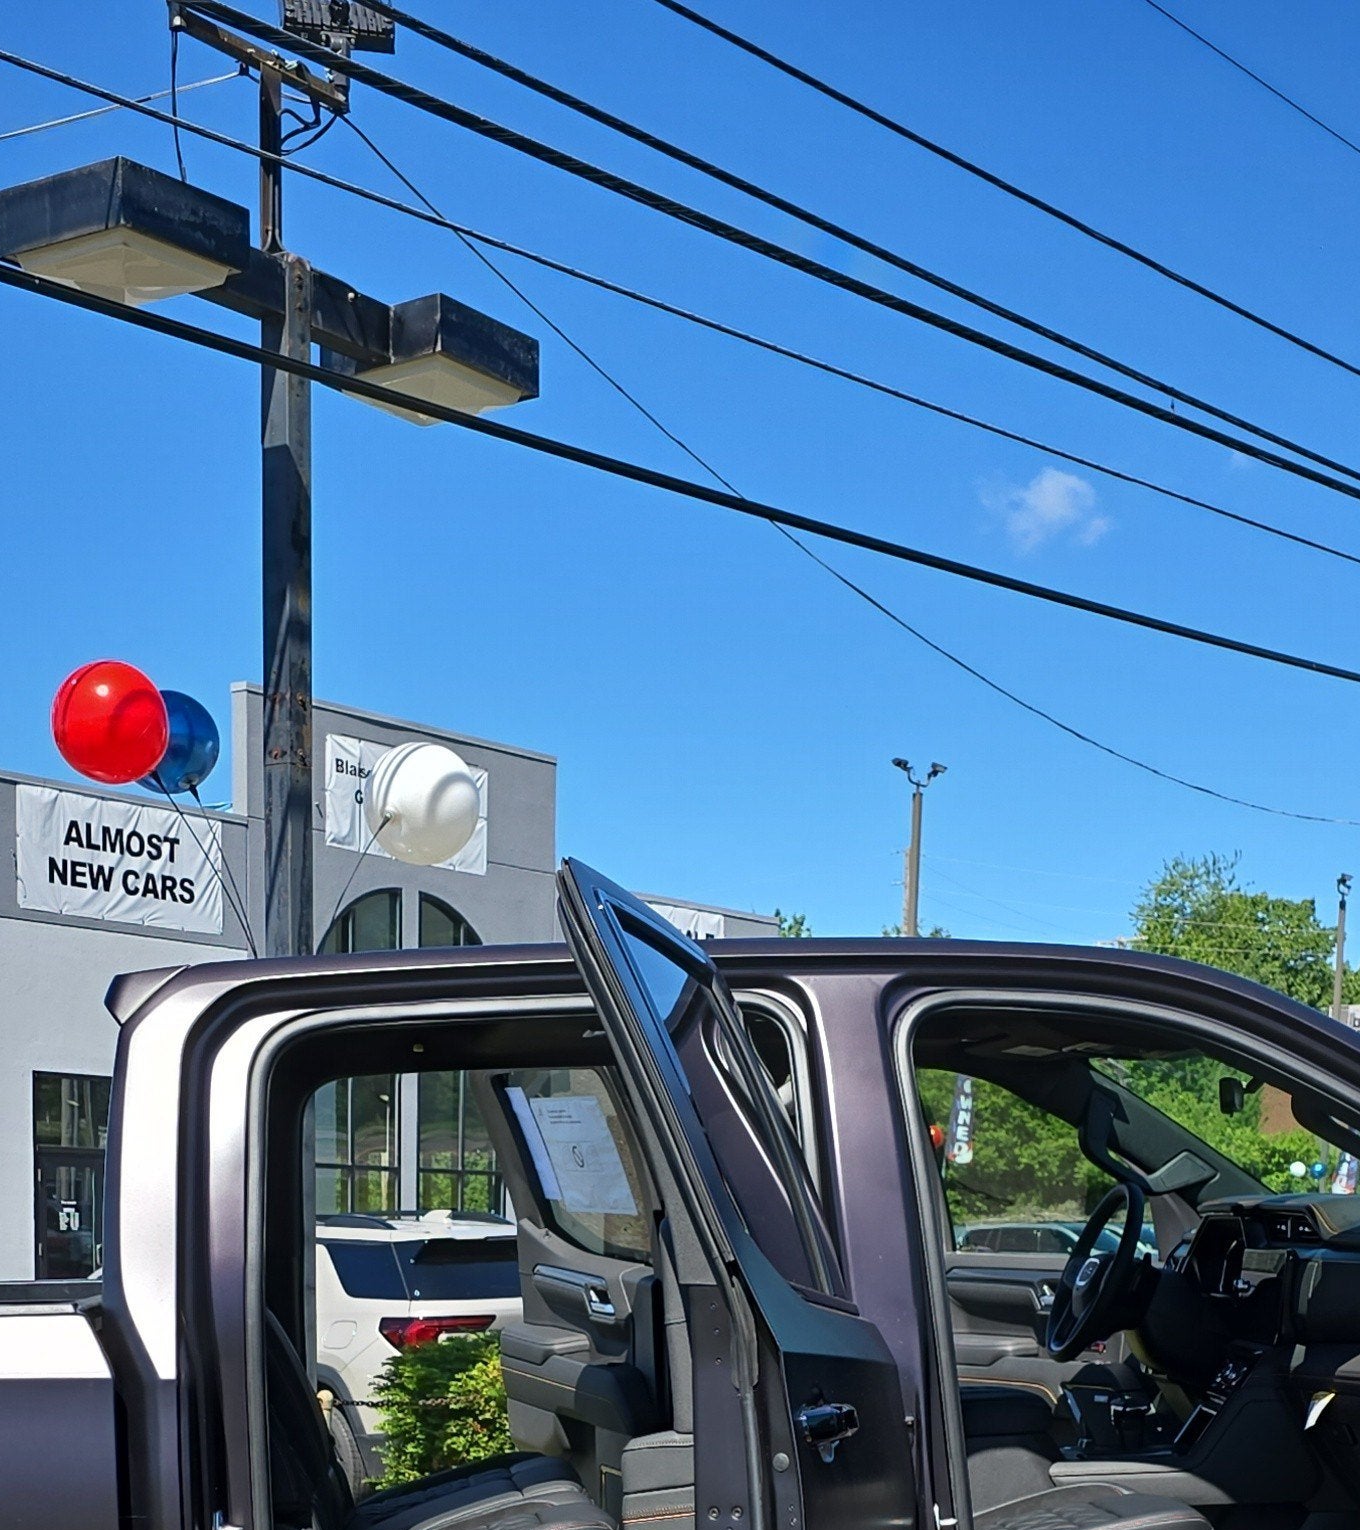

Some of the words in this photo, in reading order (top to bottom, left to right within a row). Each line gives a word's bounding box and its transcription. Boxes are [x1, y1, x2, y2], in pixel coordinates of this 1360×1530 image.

[63, 820, 180, 863] ALMOST
[48, 856, 114, 892] NEW
[122, 869, 196, 904] CARS
